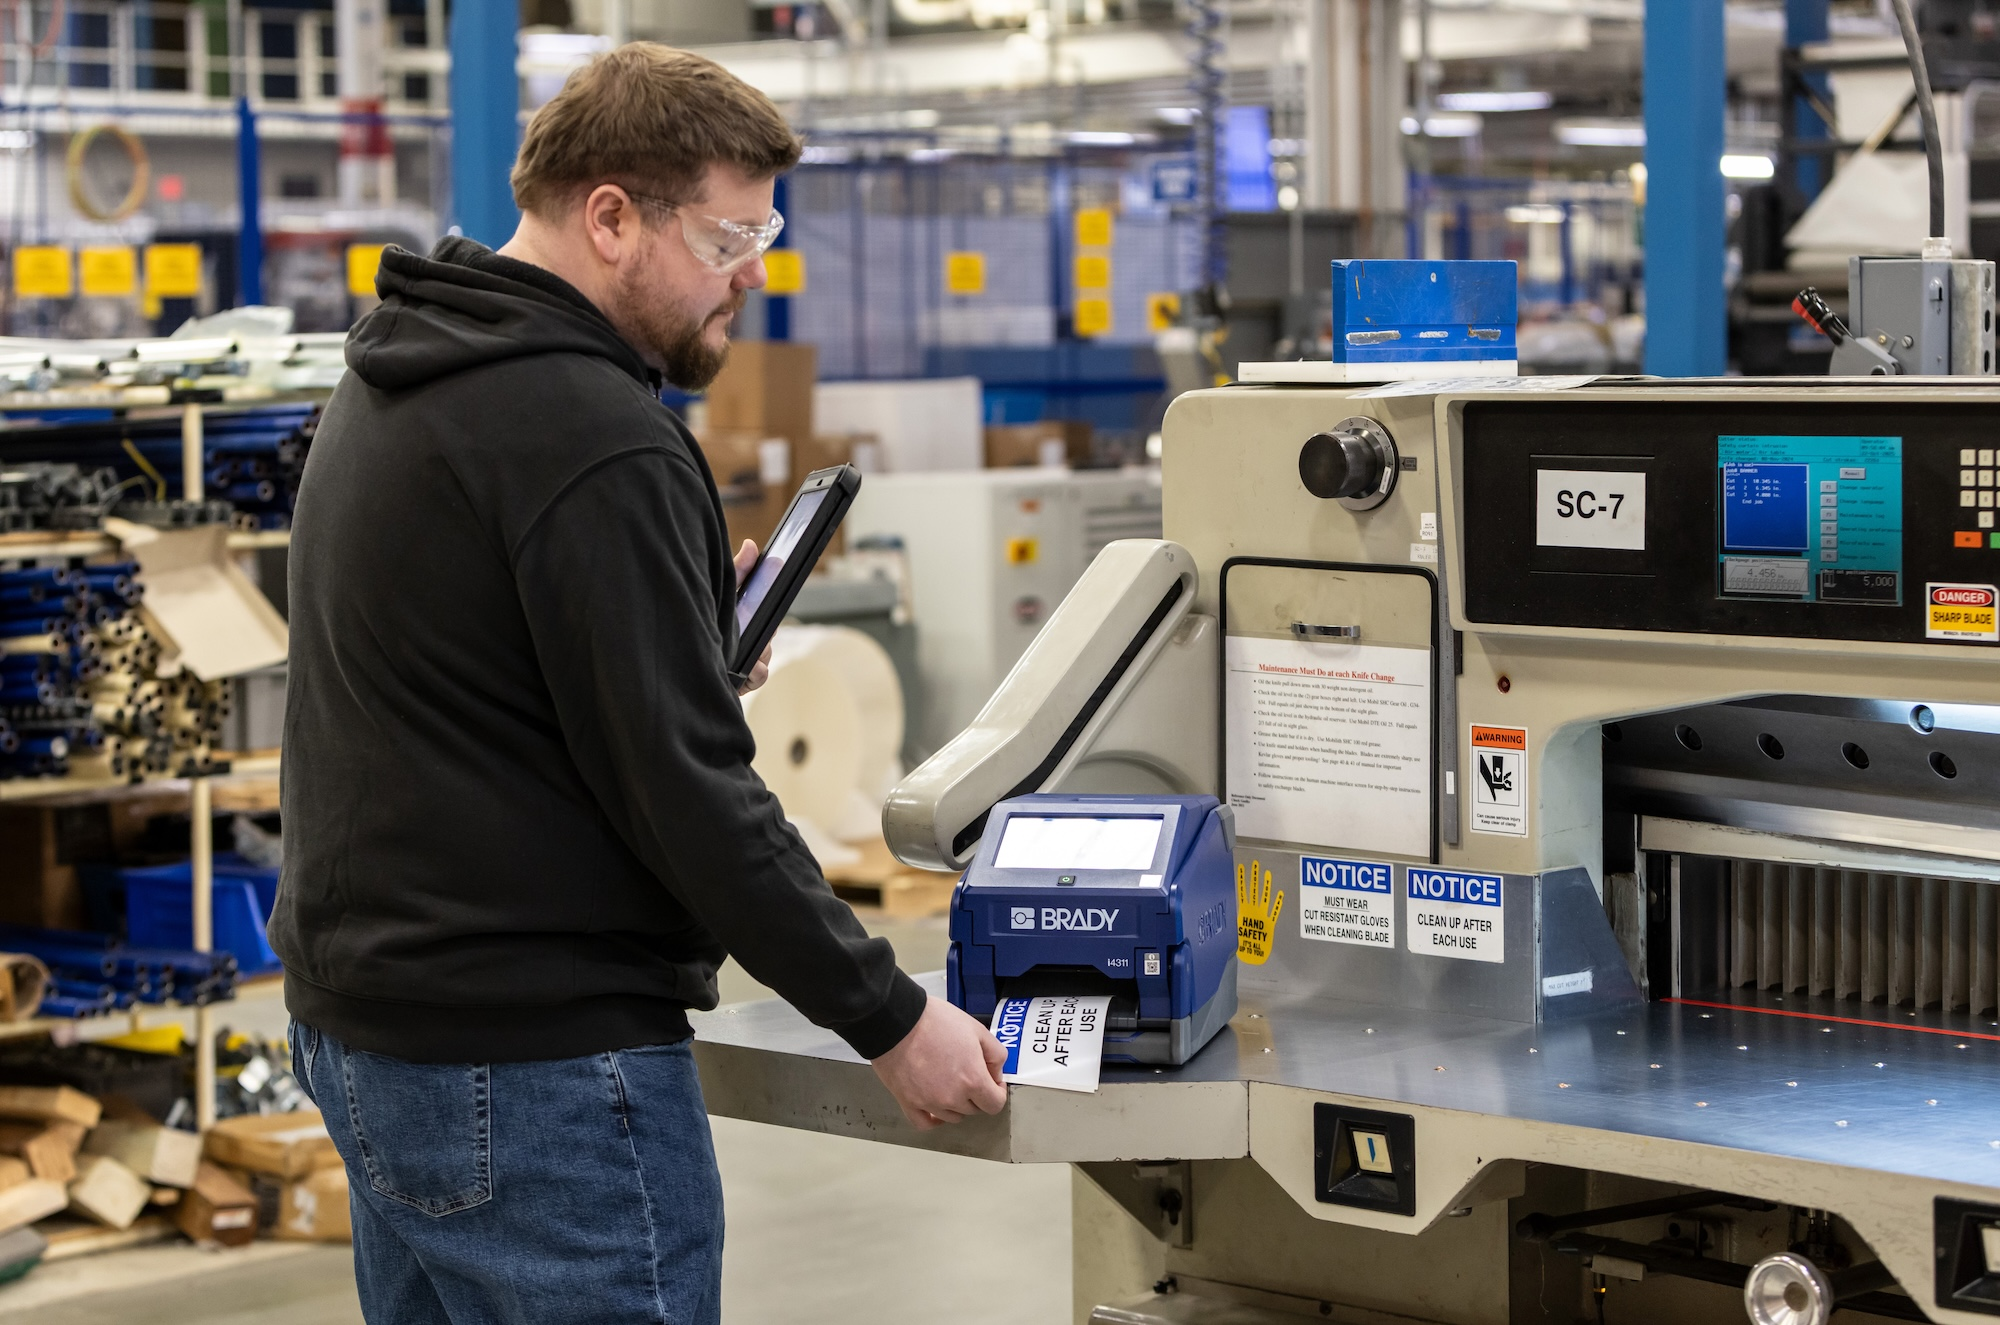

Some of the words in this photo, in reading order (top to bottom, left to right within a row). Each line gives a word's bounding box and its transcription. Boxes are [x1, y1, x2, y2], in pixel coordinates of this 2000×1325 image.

[1557, 490, 1624, 519] SC-7
[1747, 568, 1776, 578] 4.456
[1939, 591, 1985, 603] DANGER
[1933, 612, 1961, 623] SHARP
[1964, 613, 1991, 625] BLADE
[1258, 663, 1297, 673] Maintenance
[1299, 666, 1315, 675] Must
[1317, 668, 1326, 676] Do
[1335, 669, 1349, 678] each
[1351, 671, 1369, 679] Knife
[1370, 672, 1395, 683] Change
[1483, 733, 1522, 744] WARNING
[1306, 861, 1387, 890] NOTICE
[1413, 873, 1496, 903] NOTICE
[1325, 896, 1344, 907] MUST
[1346, 898, 1368, 909] WEAR
[1041, 907, 1120, 931] BRADY
[1243, 916, 1264, 930] HAND
[1304, 910, 1318, 920] CUT
[1320, 911, 1358, 924] RESISTANT
[1360, 915, 1389, 928] GLOVES
[1418, 914, 1446, 928] CLEAN
[1450, 916, 1461, 929] UP
[1464, 919, 1492, 932] AFTER
[1238, 927, 1267, 942] SAFETY
[1305, 924, 1326, 936] WHEN
[1328, 926, 1363, 940] CLEANING
[1365, 931, 1389, 943] BLADE
[1433, 934, 1457, 947] EACH
[1460, 936, 1477, 949] USE
[1246, 947, 1253, 955] TO
[1253, 942, 1261, 950] ALL
[1107, 958, 1129, 967] i4311
[1040, 998, 1057, 1009] UP
[1001, 1001, 1028, 1048] NOTICE
[1080, 1008, 1097, 1032] USE
[1033, 1010, 1053, 1054] CLEAN
[1054, 1018, 1073, 1067] AFTER
